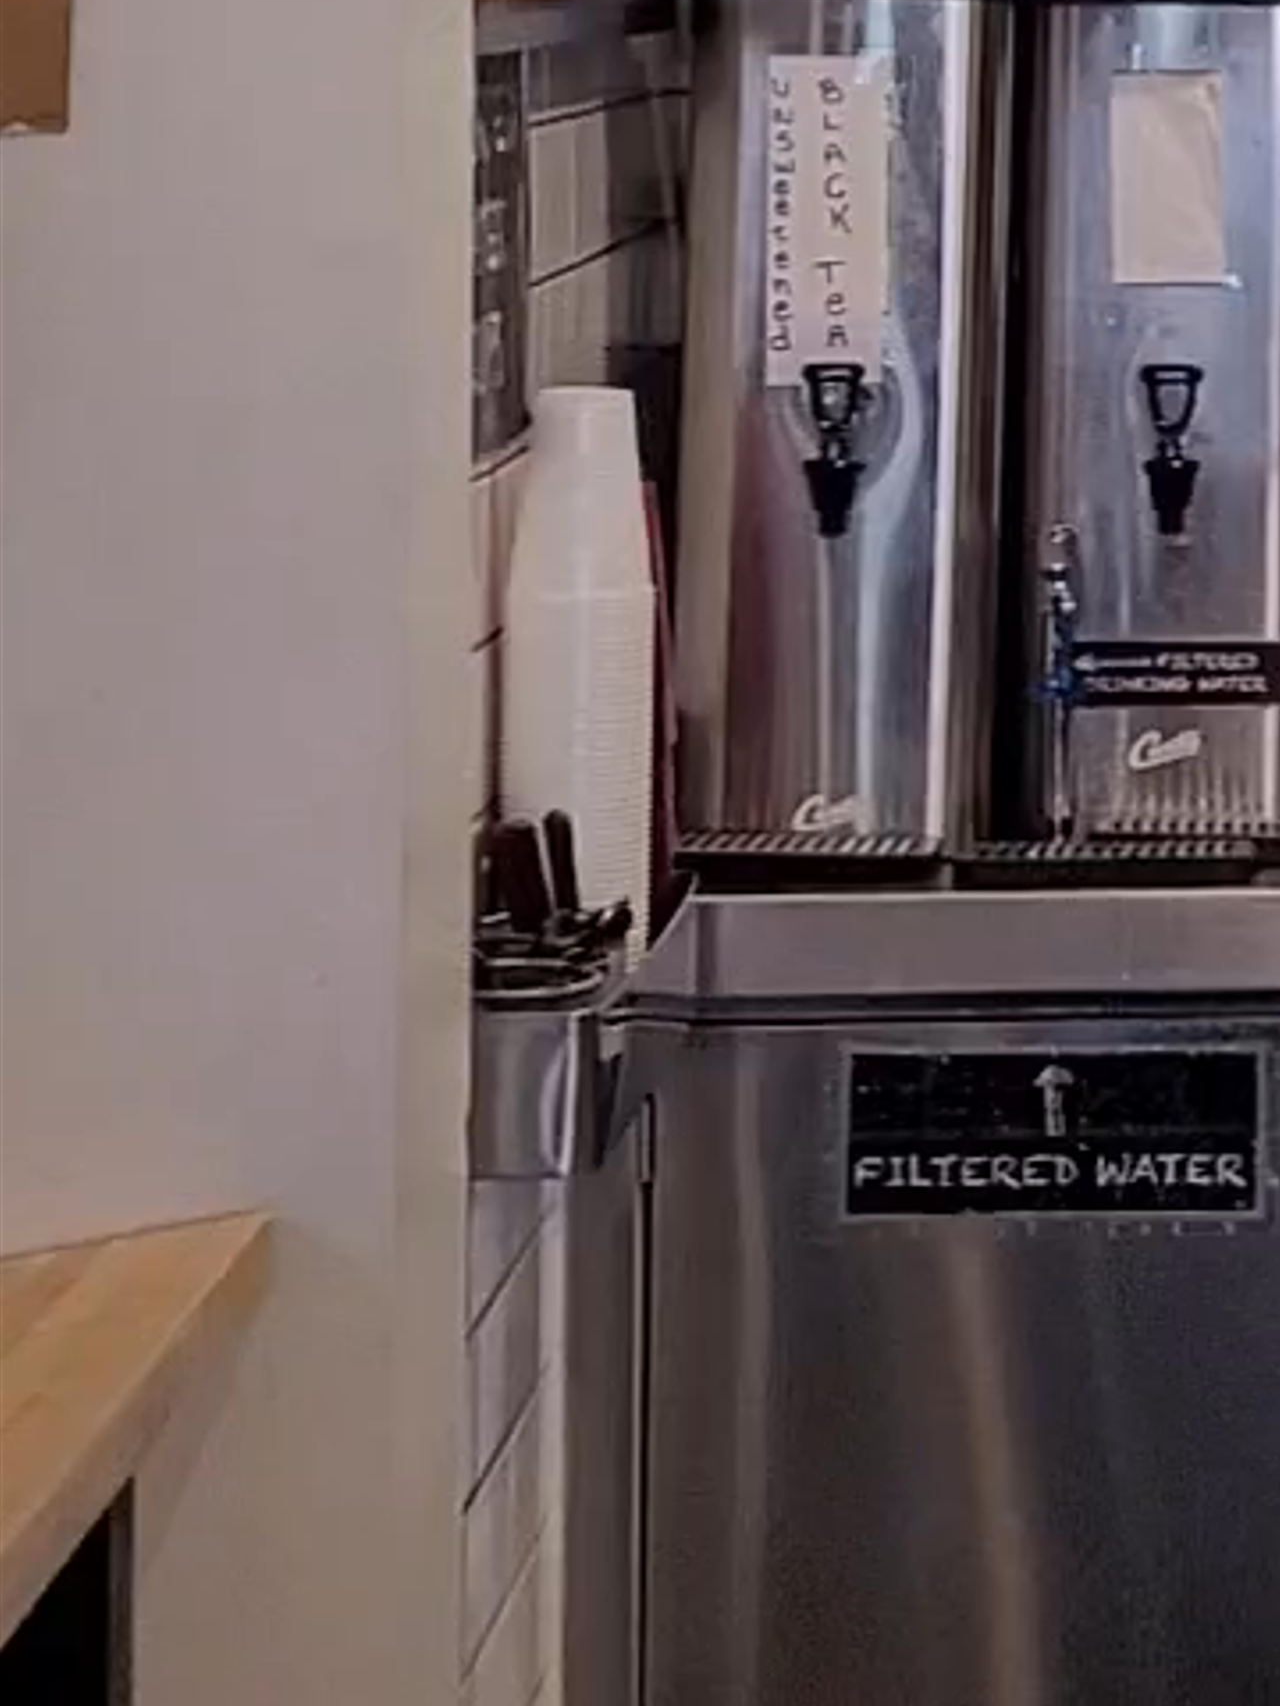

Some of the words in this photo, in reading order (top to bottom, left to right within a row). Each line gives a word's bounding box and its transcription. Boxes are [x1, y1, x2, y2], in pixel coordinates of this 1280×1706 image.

[817, 77, 852, 235] BLACK
[1196, 674, 1271, 693] WATER
[852, 1153, 1080, 1190] FILTERED
[1095, 1152, 1248, 1188] WATER
